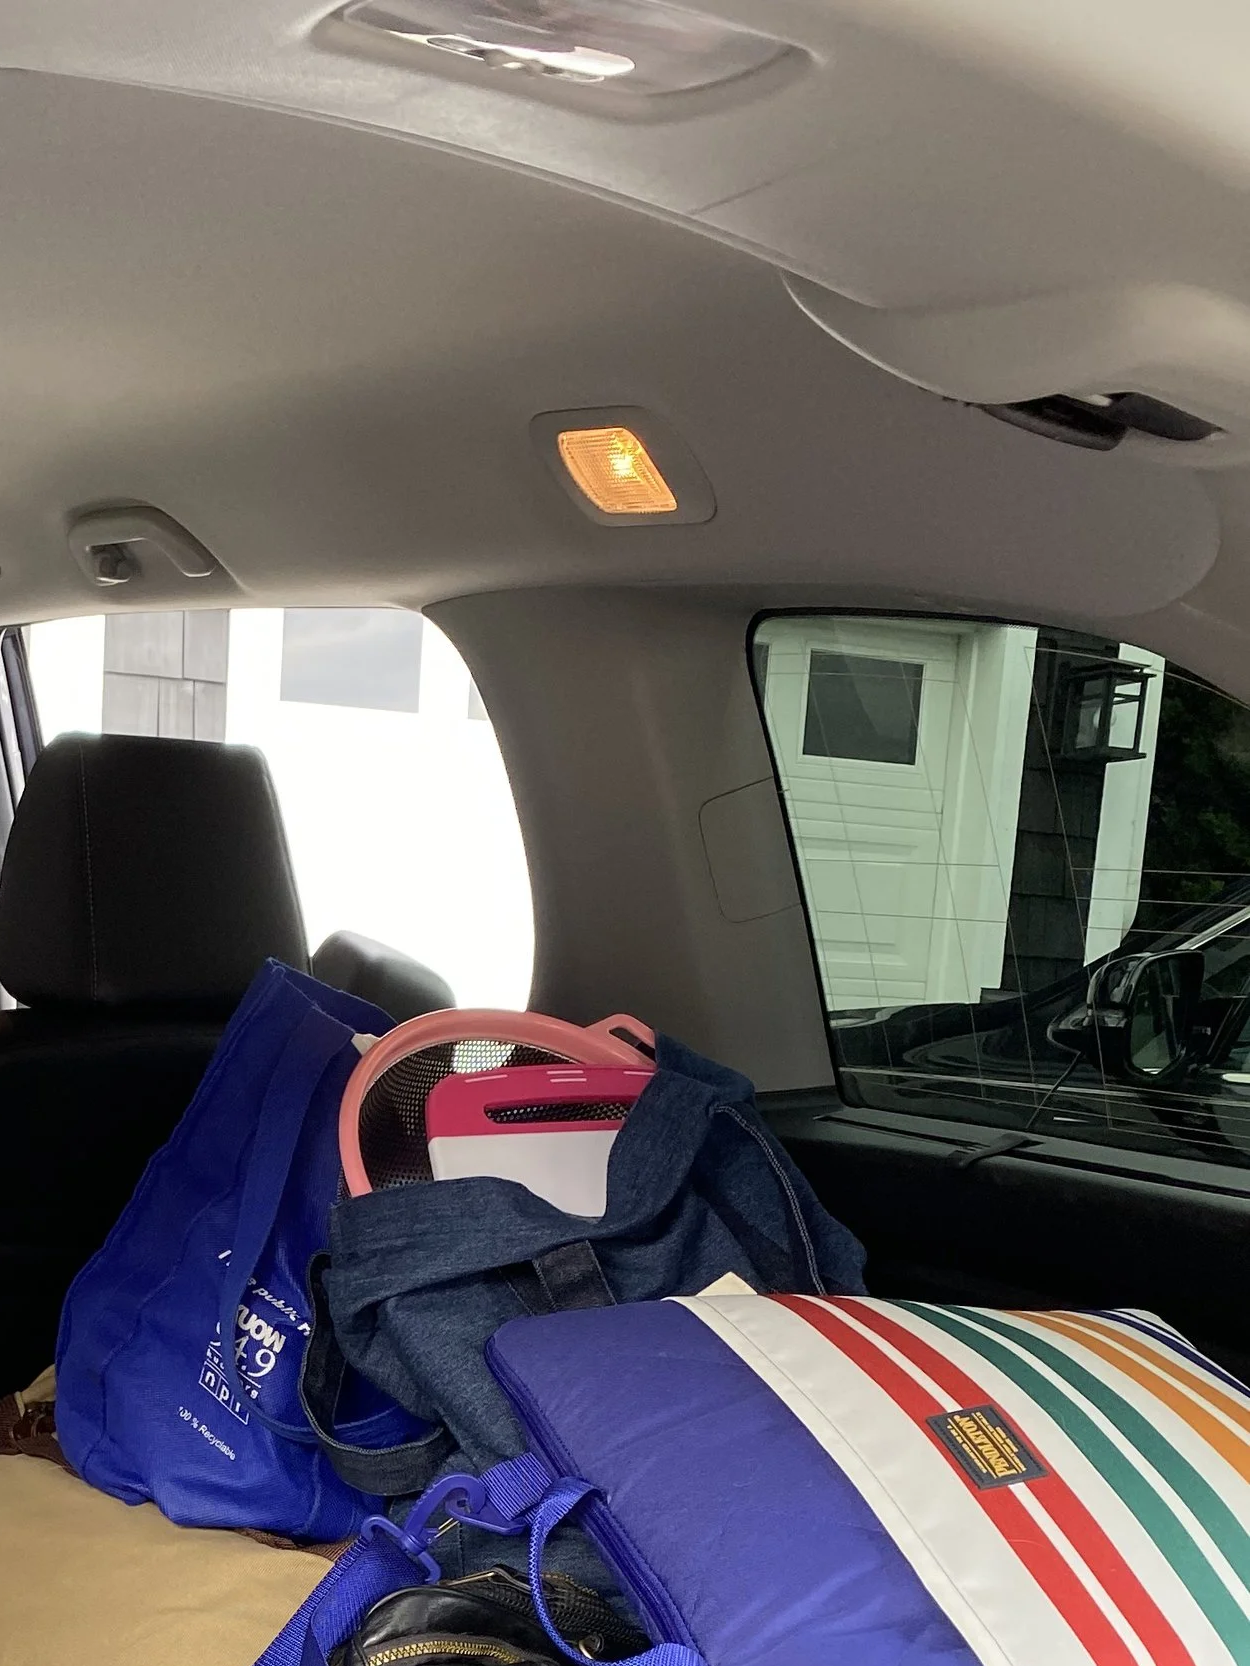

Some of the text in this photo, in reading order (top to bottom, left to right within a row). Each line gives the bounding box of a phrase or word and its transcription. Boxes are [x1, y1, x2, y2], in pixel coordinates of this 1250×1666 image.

[253, 1287, 300, 1322] public
[198, 1424, 236, 1461] Recyclable
[953, 1414, 1018, 1478] PENDLETON
